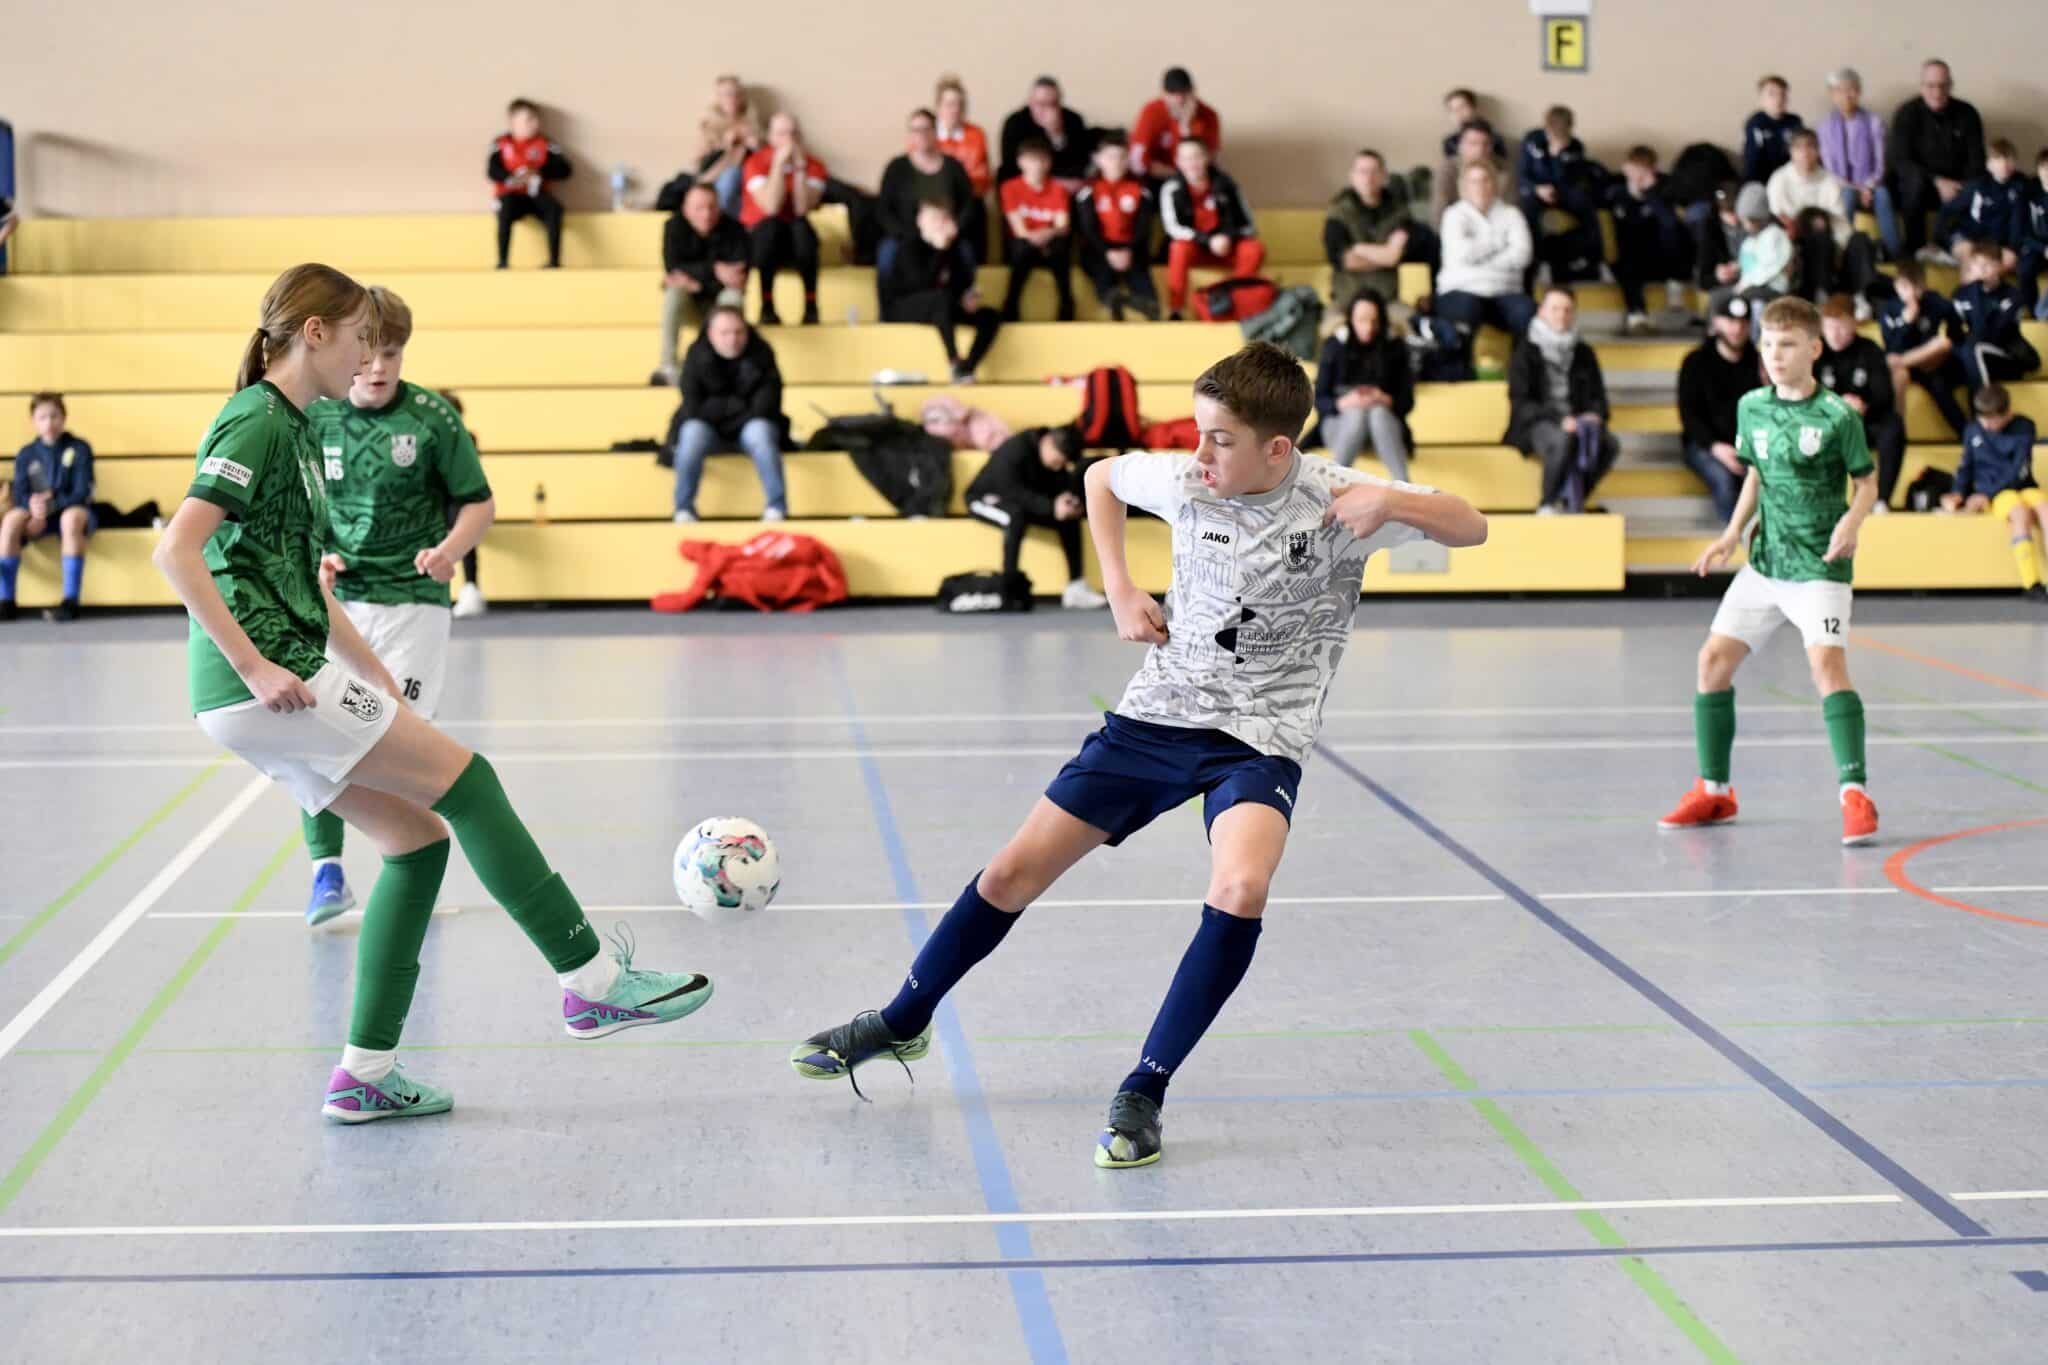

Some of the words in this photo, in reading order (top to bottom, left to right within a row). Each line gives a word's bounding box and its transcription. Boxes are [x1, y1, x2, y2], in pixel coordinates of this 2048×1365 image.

[1555, 25, 1575, 63] F
[1201, 531, 1231, 545] JAKO
[1823, 617, 1840, 634] 12
[403, 677, 422, 700] 16
